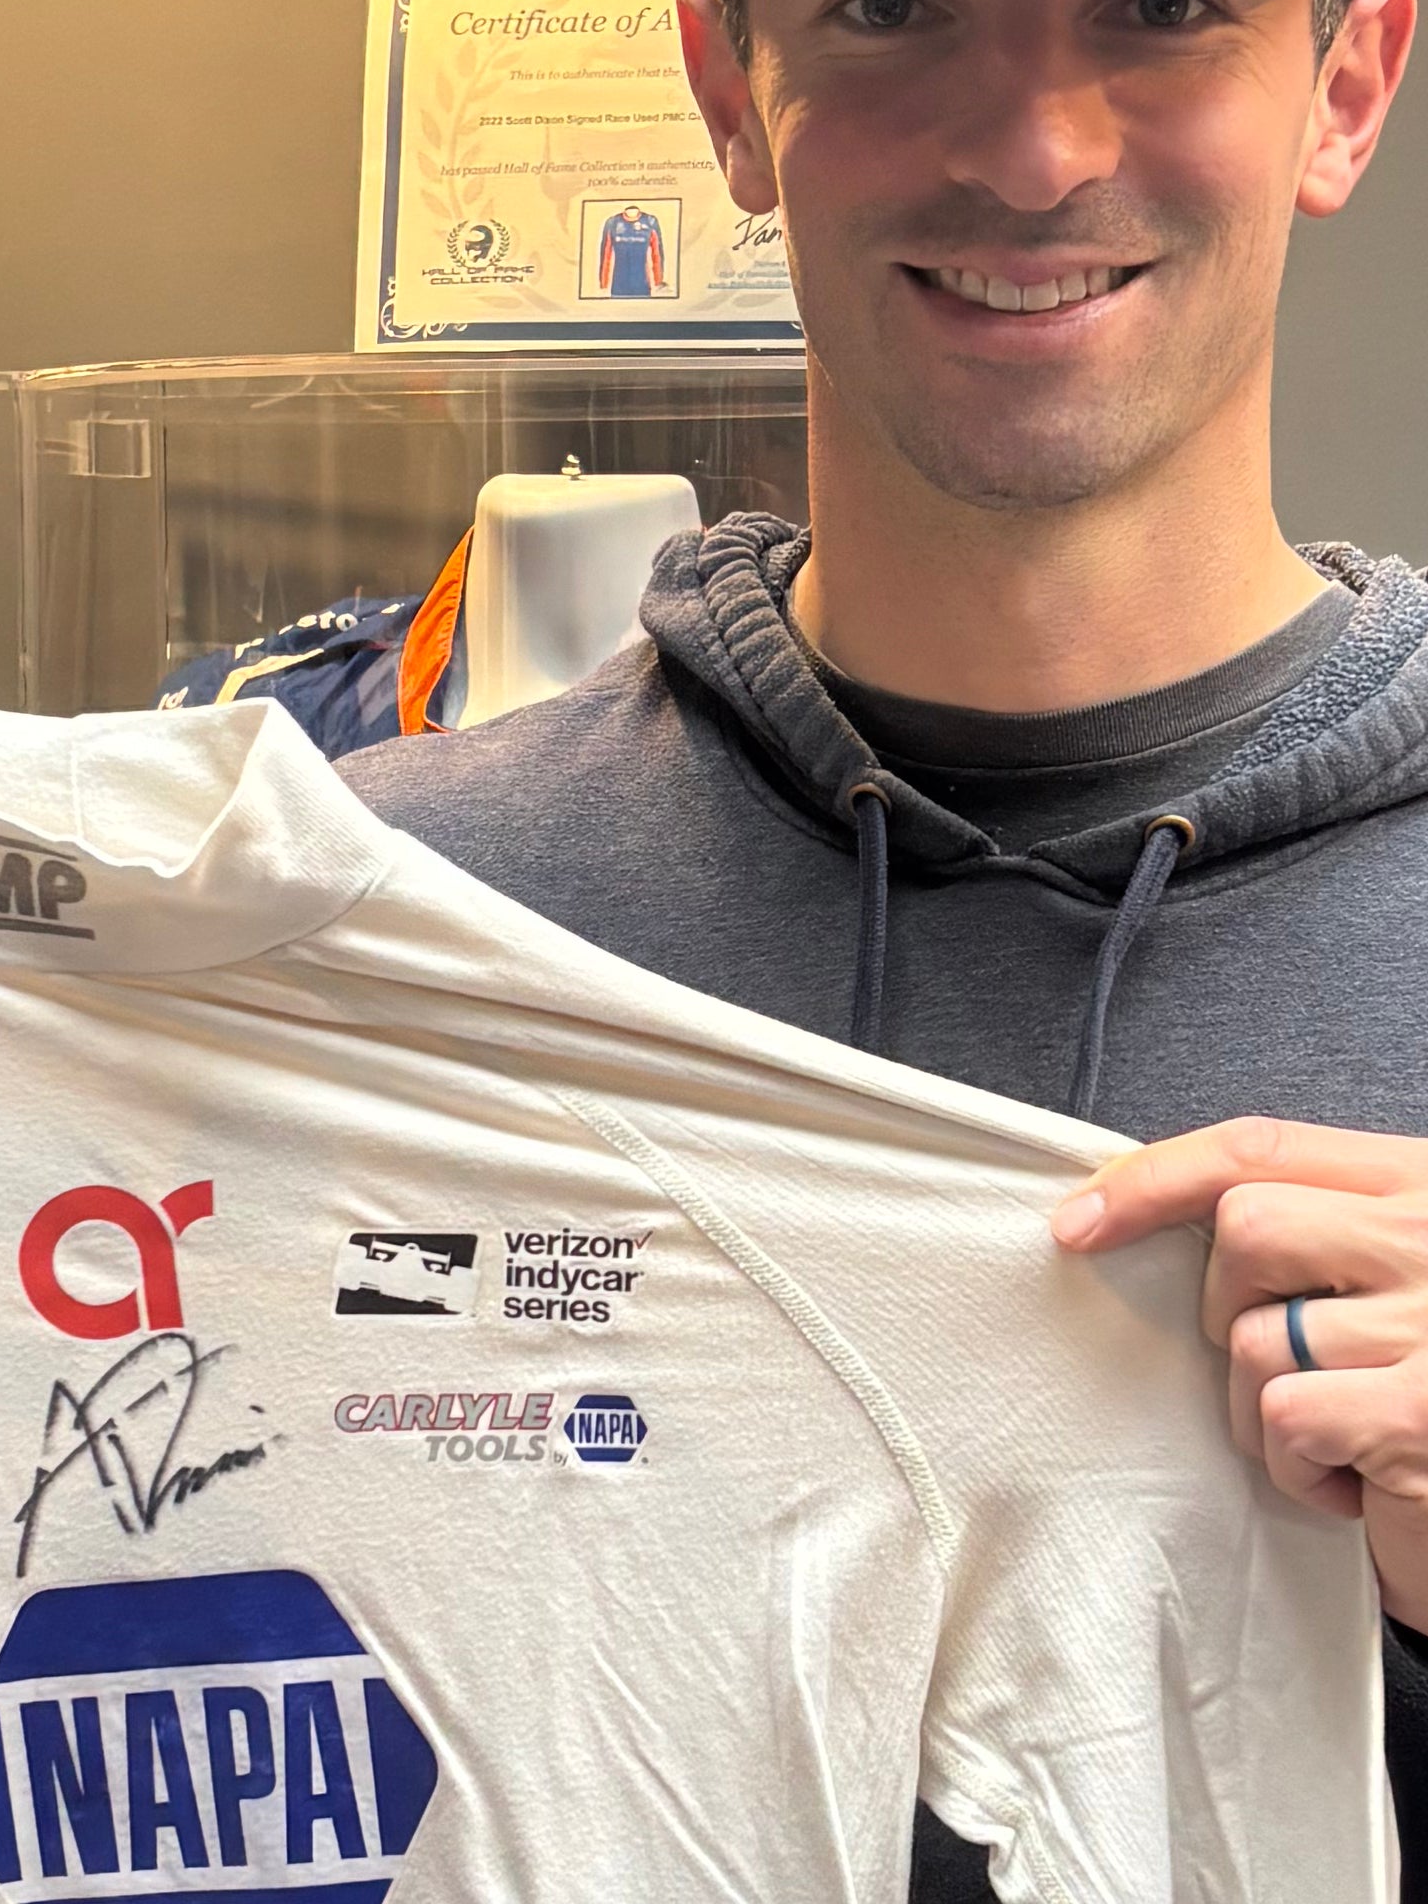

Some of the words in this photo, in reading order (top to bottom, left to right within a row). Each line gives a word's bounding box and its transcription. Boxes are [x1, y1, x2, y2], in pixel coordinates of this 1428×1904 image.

[450, 9, 607, 41] Certificate
[616, 7, 652, 39] of
[510, 70, 534, 81] This
[536, 71, 547, 81] is
[549, 71, 561, 81] to
[562, 68, 635, 80] authenticate
[637, 67, 660, 78] that
[662, 67, 681, 77] the
[567, 114, 602, 126] Signed
[605, 114, 631, 123] Race
[633, 113, 659, 123] Used
[440, 165, 461, 177] has
[462, 163, 502, 178] passed
[504, 162, 530, 174] Hall
[531, 162, 545, 175] of
[430, 276, 524, 285] COLLECTION
[504, 1228, 636, 1260] verizon
[505, 1258, 640, 1296] indycar
[503, 1296, 611, 1323] series
[334, 1393, 556, 1434] CARLYLE
[578, 1413, 636, 1445] NAPA
[426, 1435, 549, 1463] TOOLS
[553, 1451, 569, 1467] by
[20, 1680, 369, 1878] NAPA
